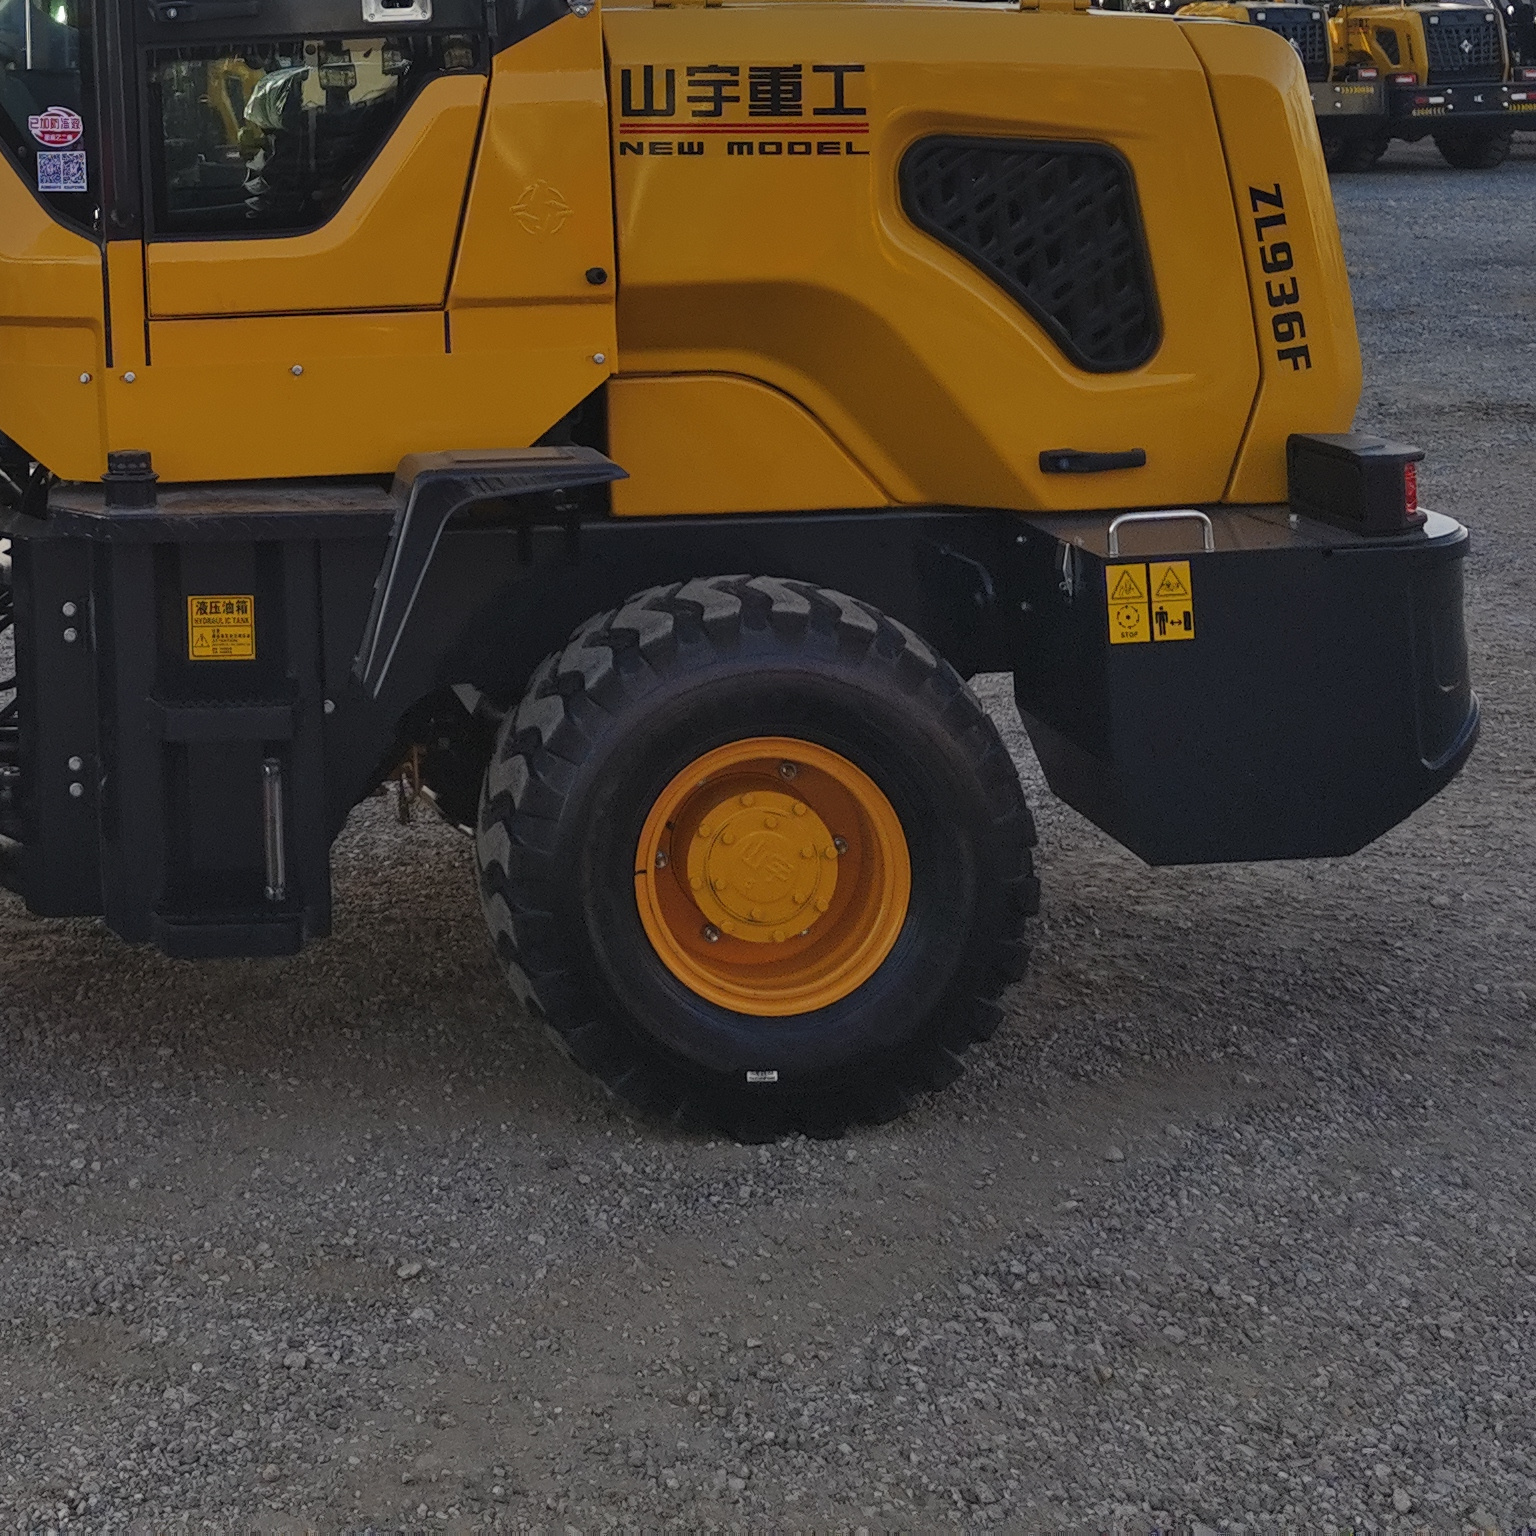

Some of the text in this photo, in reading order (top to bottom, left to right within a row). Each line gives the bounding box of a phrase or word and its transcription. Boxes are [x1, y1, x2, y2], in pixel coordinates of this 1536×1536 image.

[620, 64, 868, 118] 山宇重工
[619, 141, 871, 156] NEW MODEL
[1248, 182, 1313, 372] ZL936F
[195, 600, 249, 615] 液压油箱
[1120, 631, 1139, 639] STOP
